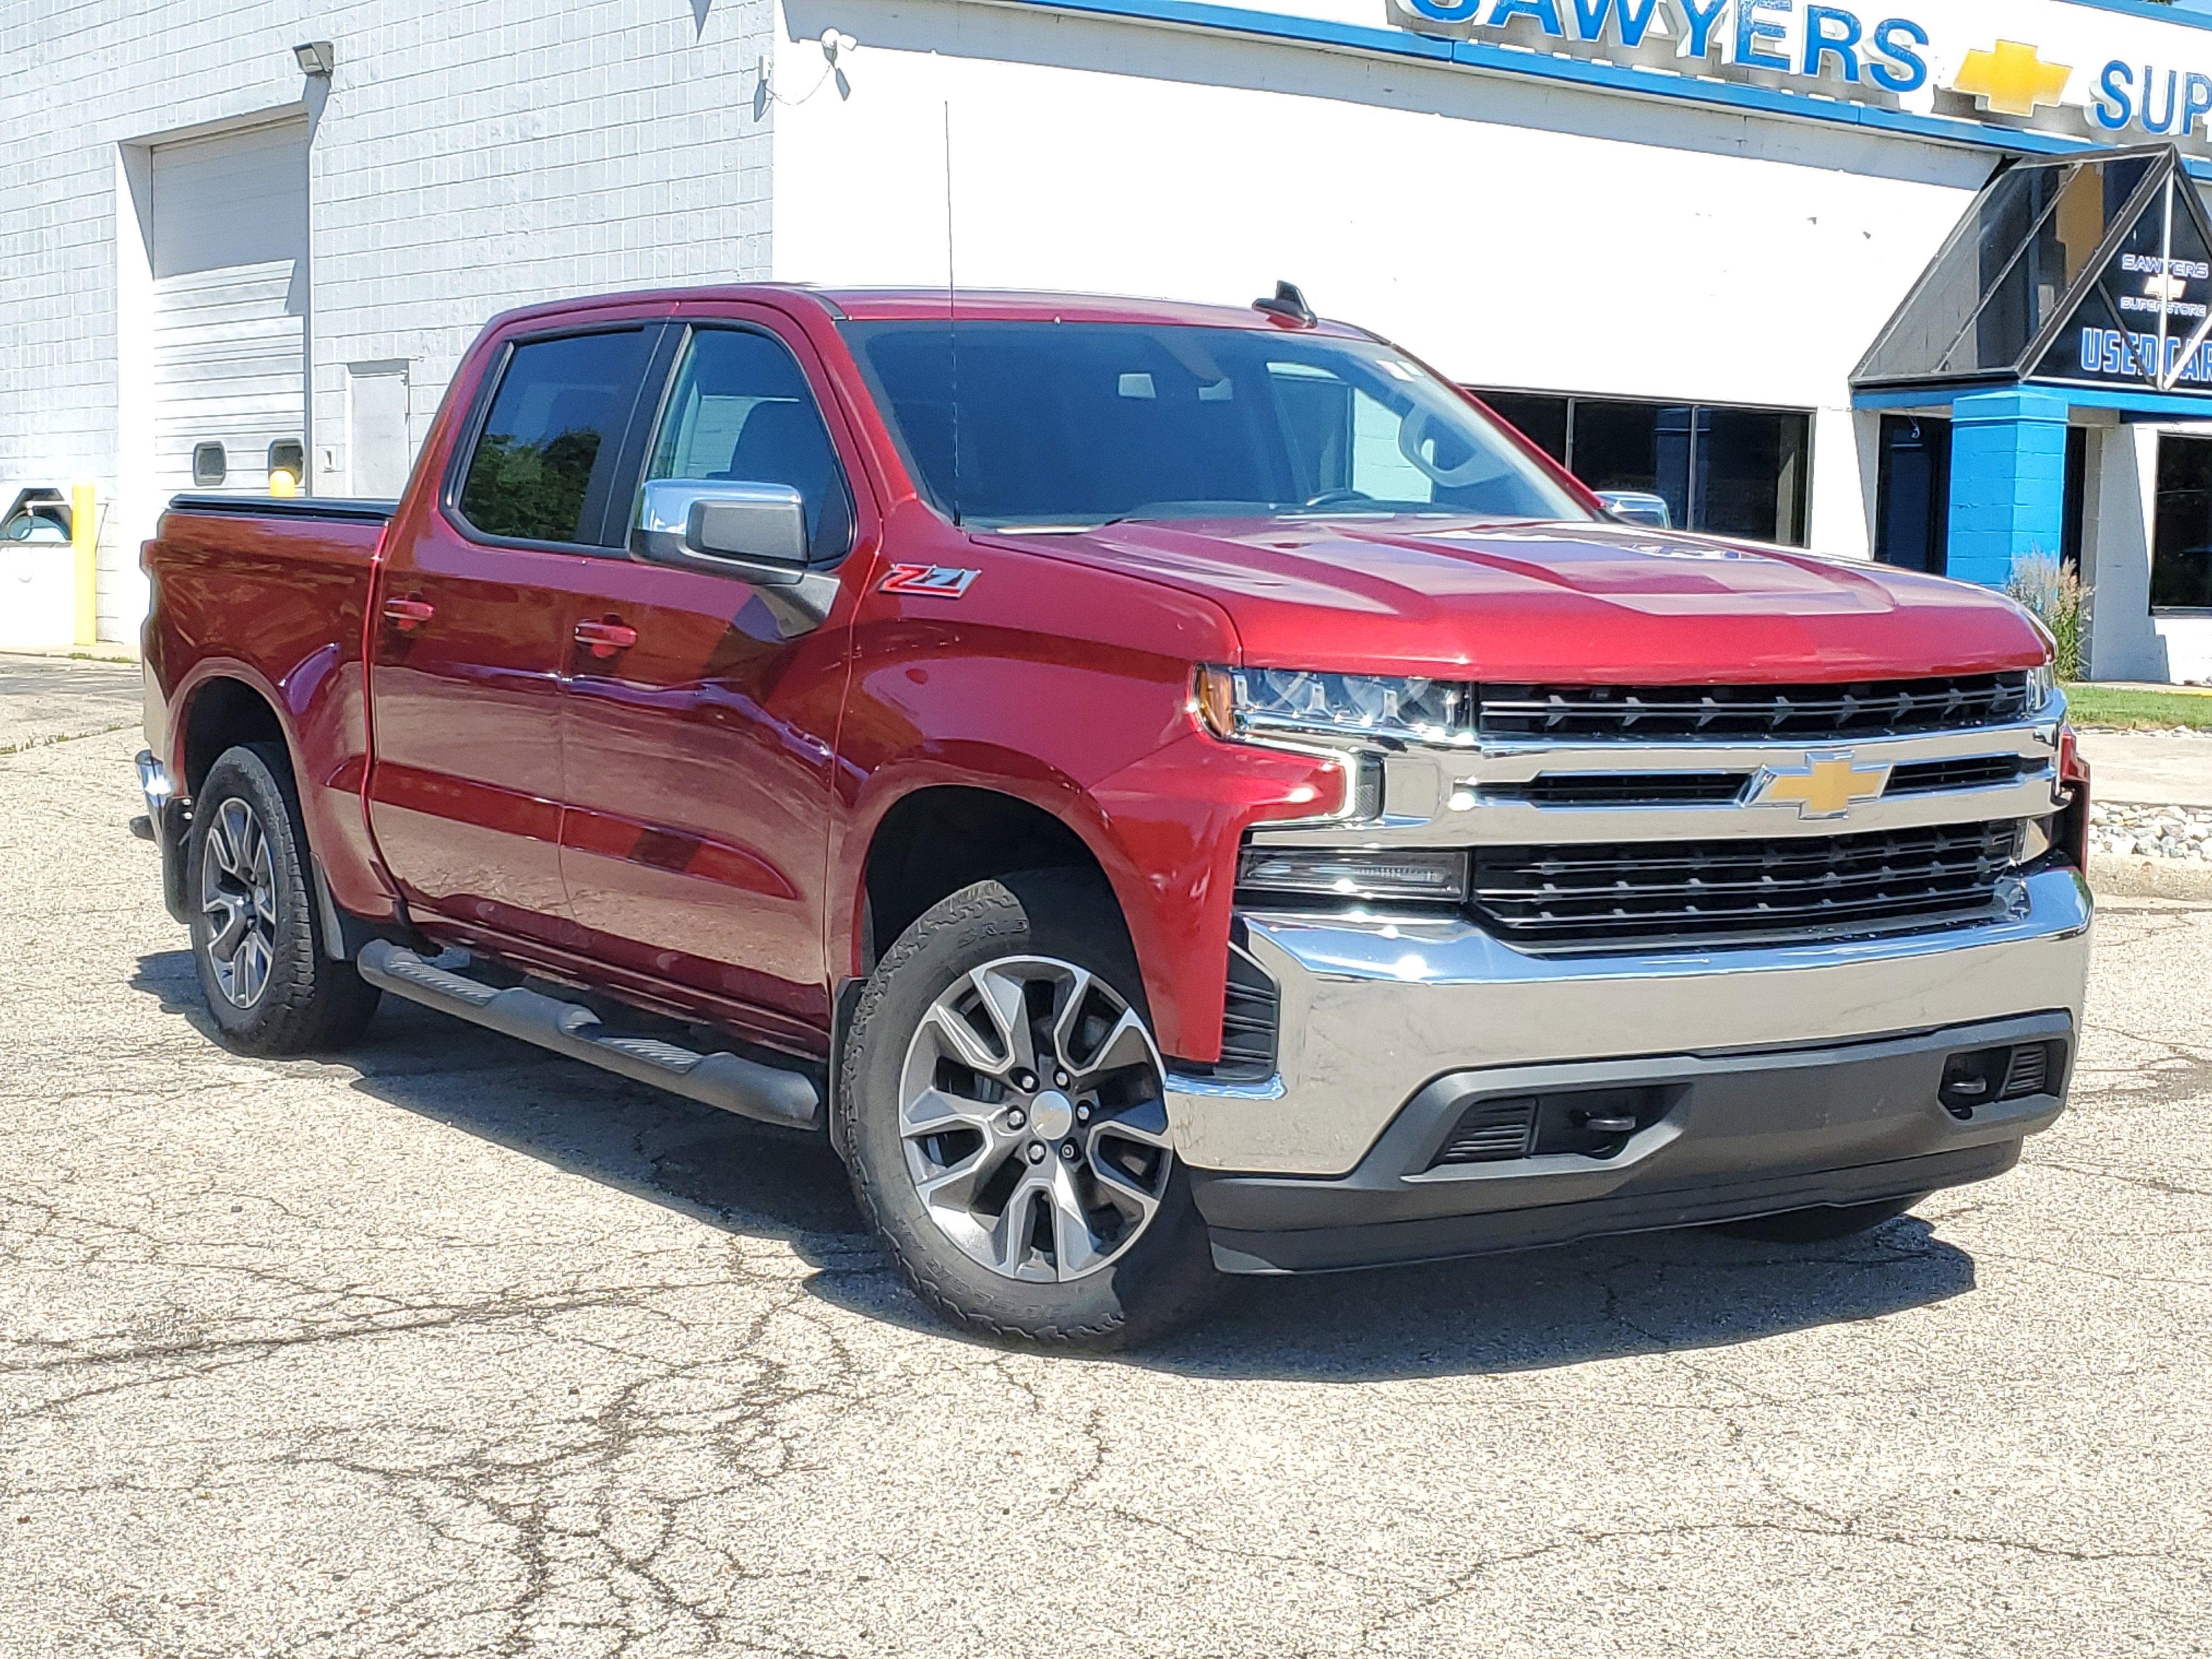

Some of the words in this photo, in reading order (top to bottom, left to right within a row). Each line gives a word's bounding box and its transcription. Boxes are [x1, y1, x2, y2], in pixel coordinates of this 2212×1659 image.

[1400, 0, 1928, 92] WYERS
[2081, 327, 2159, 377] USED
[879, 563, 981, 598] Z71
